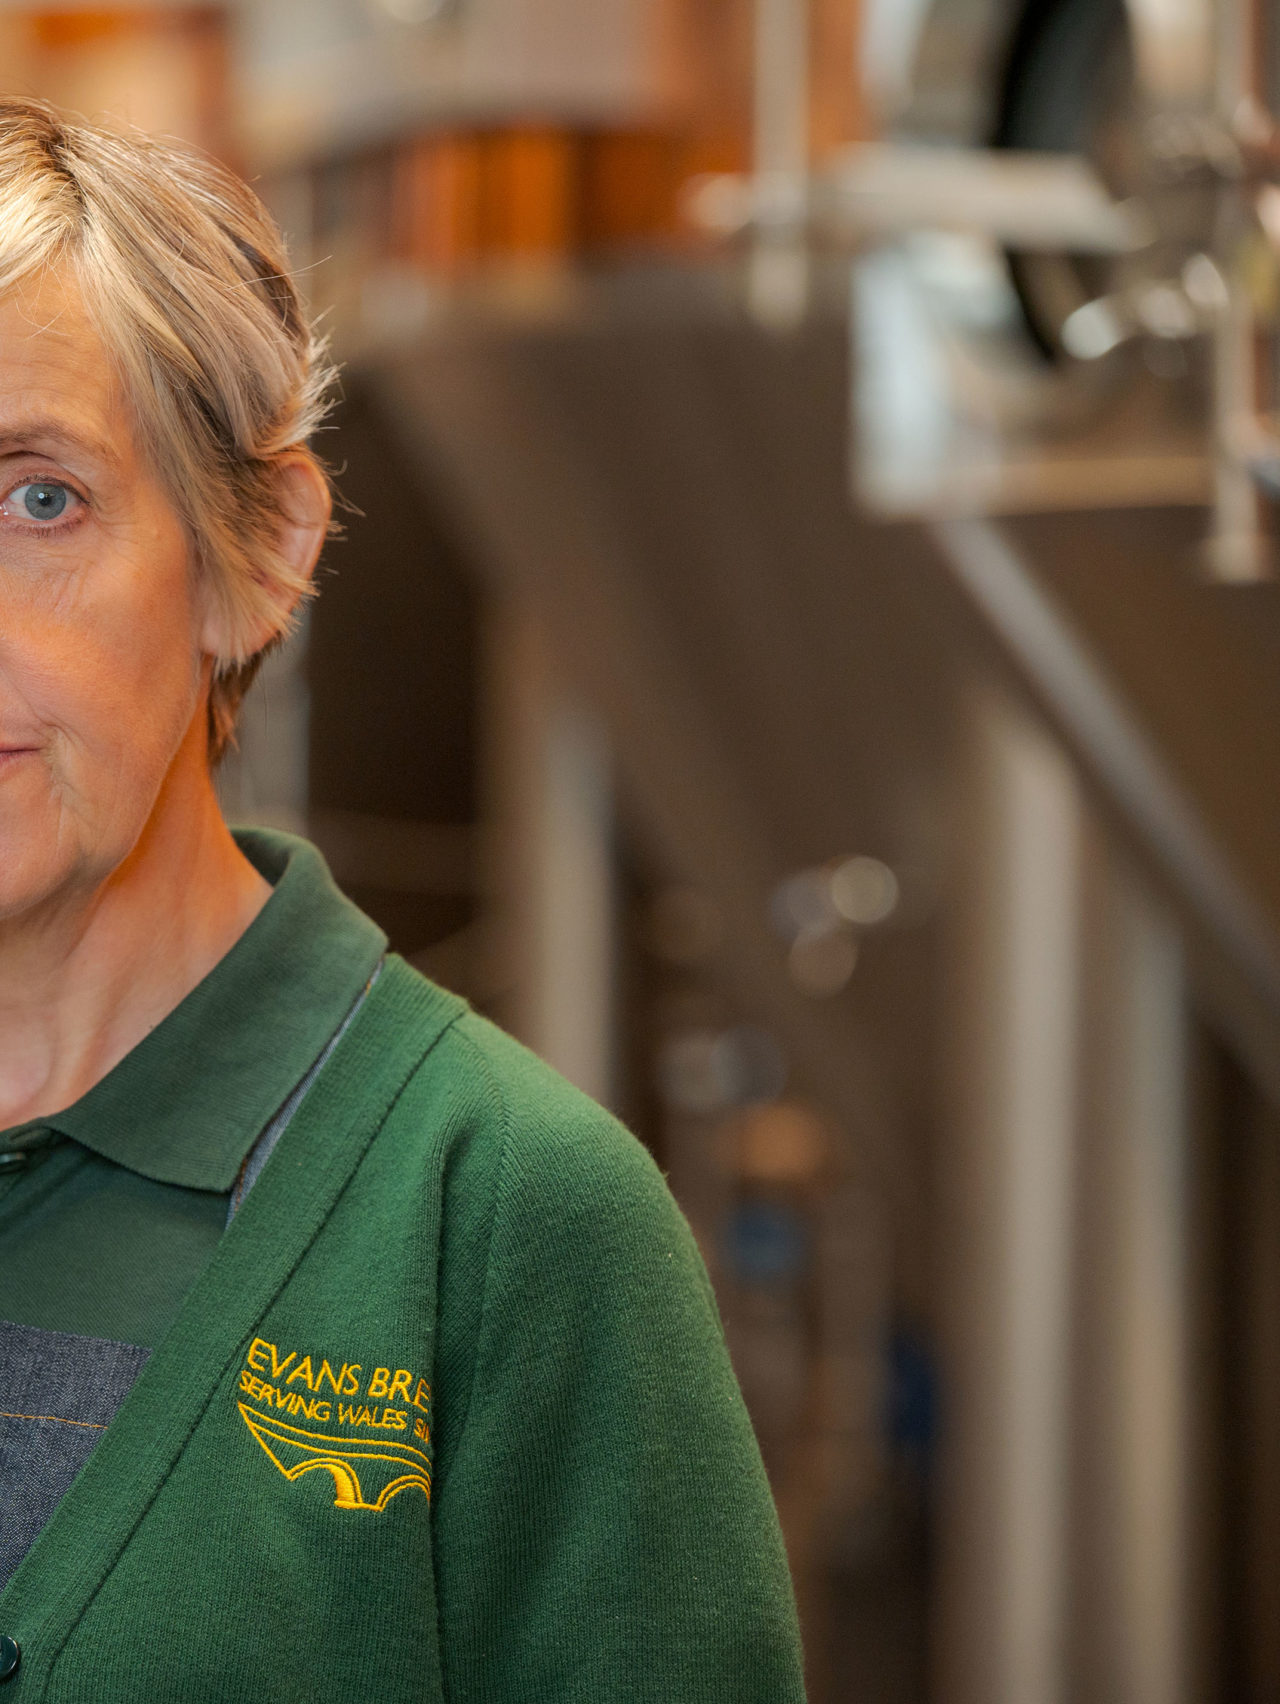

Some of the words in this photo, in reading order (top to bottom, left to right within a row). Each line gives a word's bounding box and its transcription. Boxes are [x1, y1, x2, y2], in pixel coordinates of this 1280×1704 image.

[247, 1337, 362, 1395] EVANS
[239, 1370, 332, 1421] SERVING
[338, 1402, 408, 1430] WALES
